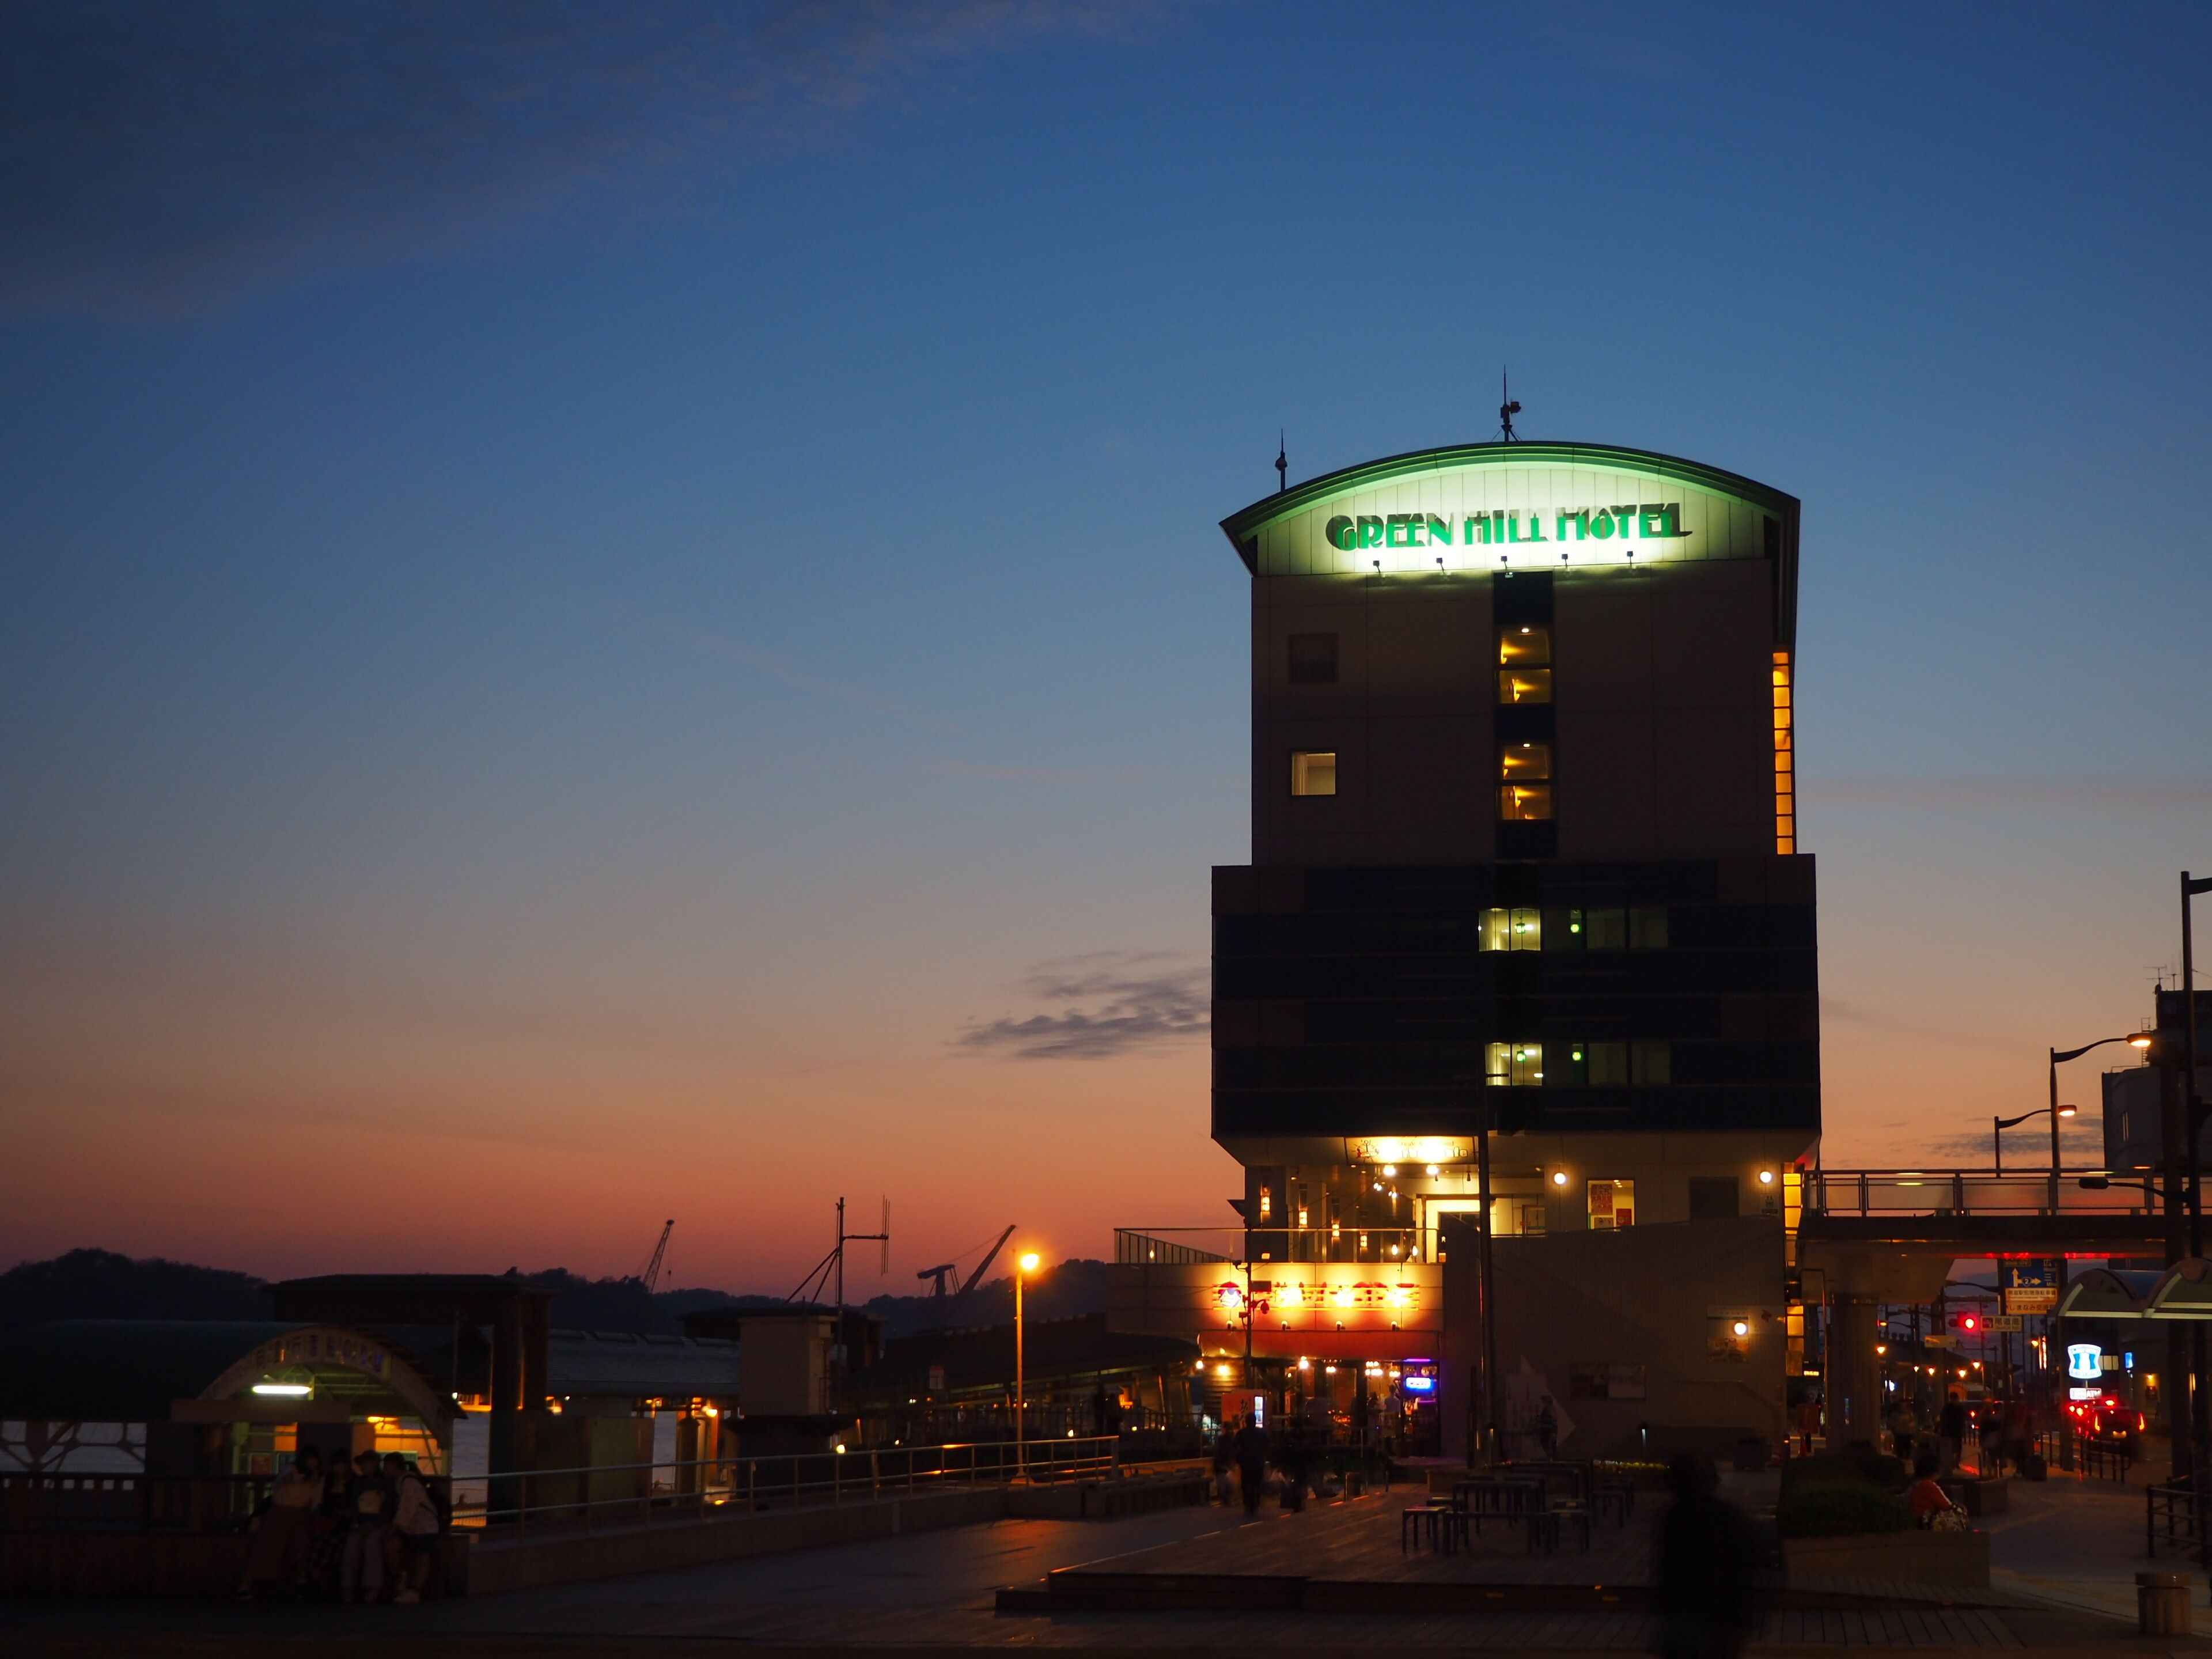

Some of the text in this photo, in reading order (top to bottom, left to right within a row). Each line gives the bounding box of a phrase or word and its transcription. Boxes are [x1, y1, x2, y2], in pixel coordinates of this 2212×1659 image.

[1335, 512, 1677, 551] GREEN HILL HOTEL
